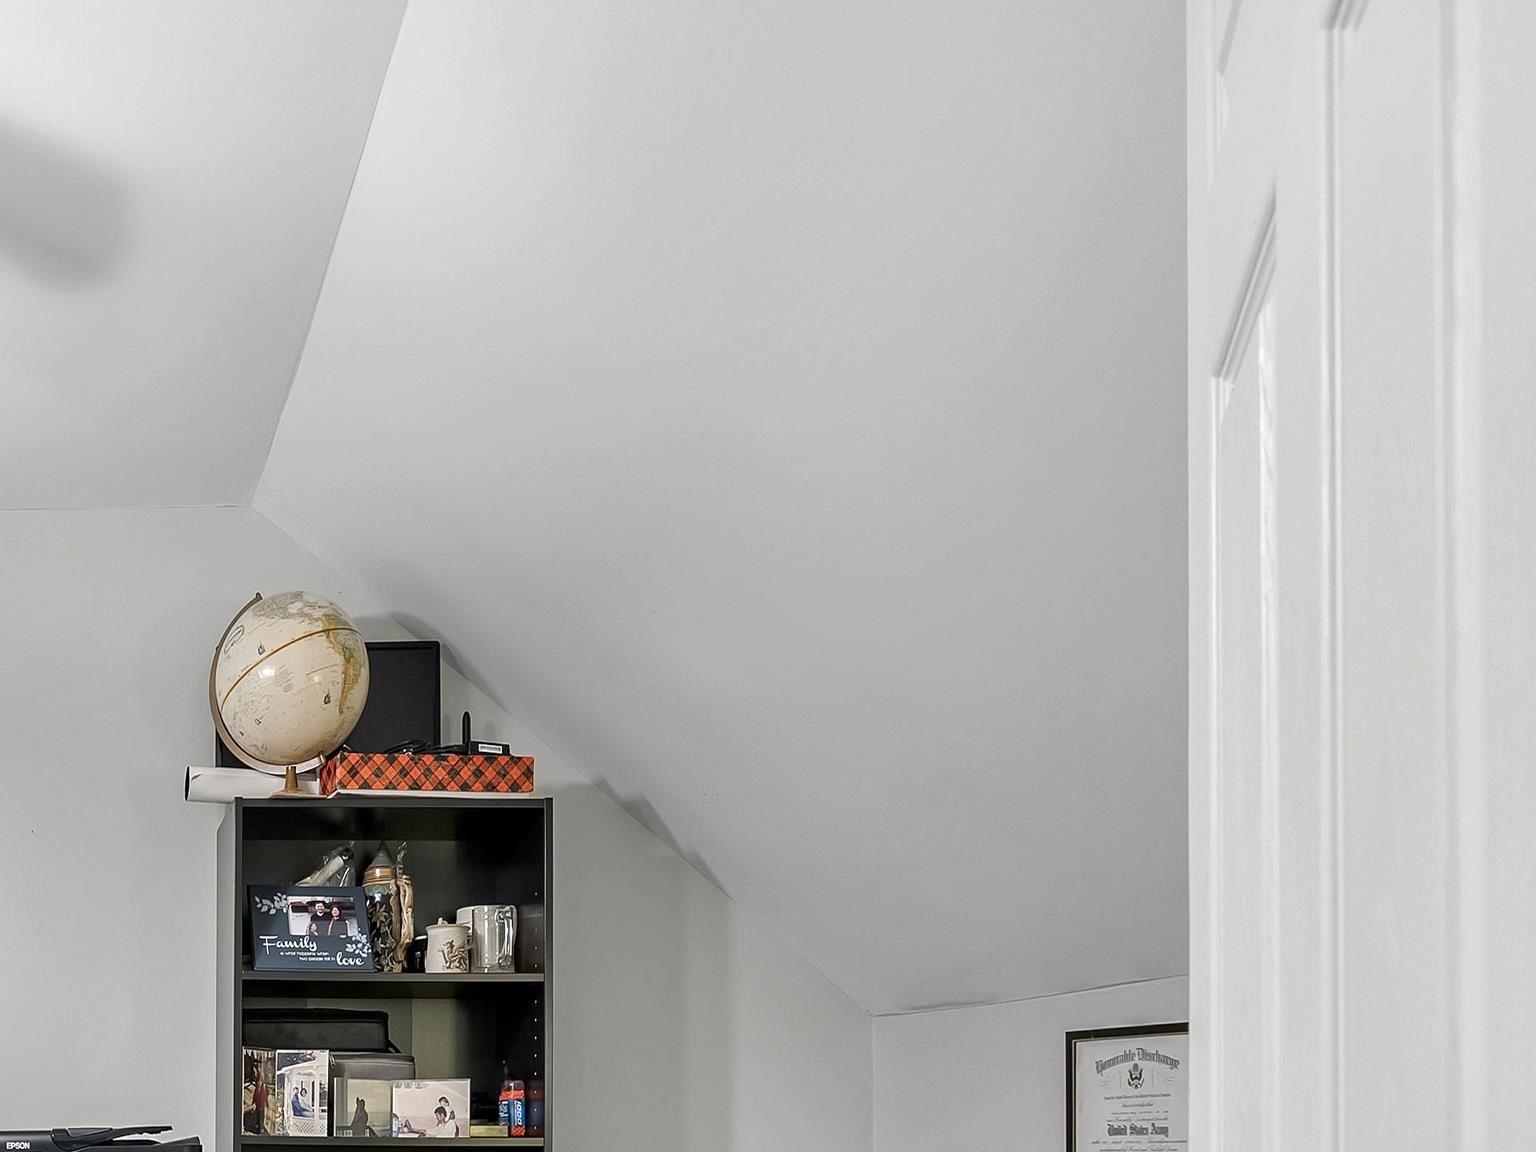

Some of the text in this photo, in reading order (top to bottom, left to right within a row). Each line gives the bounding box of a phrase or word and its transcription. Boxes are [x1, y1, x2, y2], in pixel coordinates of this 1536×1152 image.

[259, 935, 317, 955] Family
[336, 952, 364, 966] love
[1136, 1047, 1180, 1070] Discharge
[6, 1142, 30, 1150] EPSON
